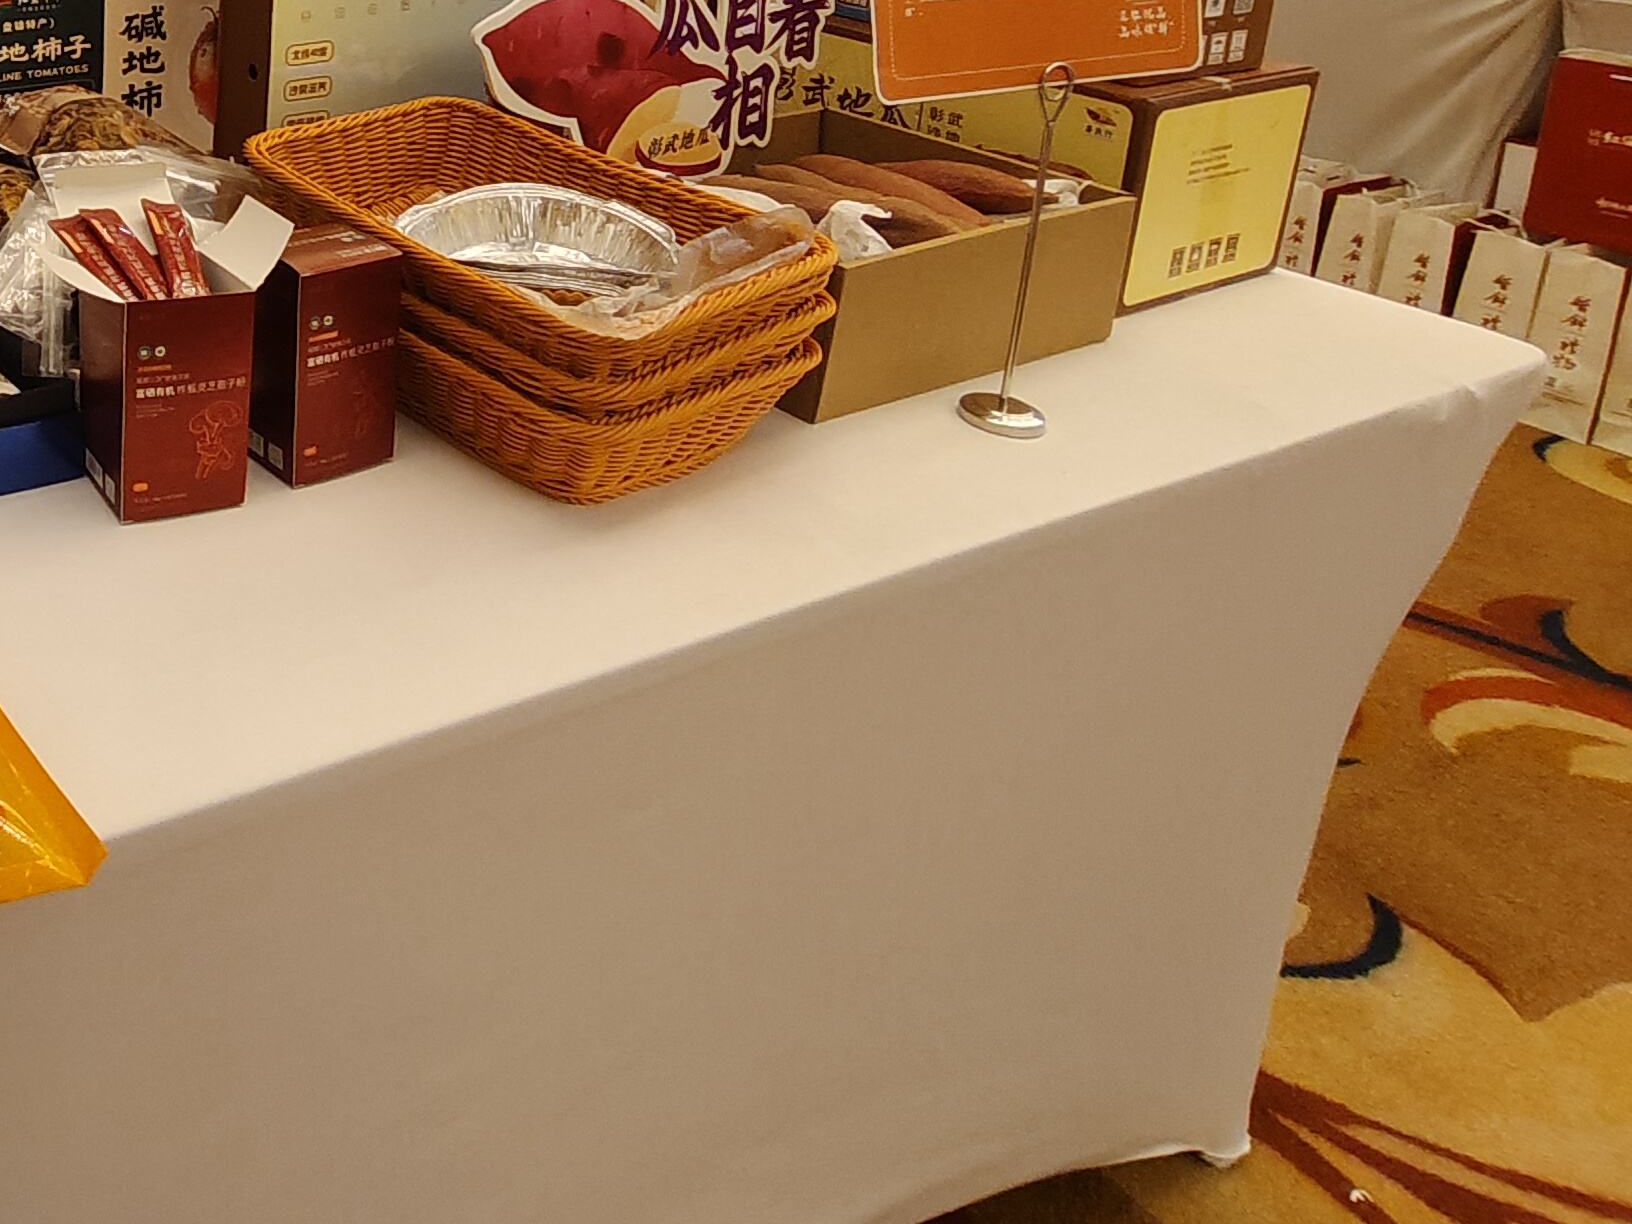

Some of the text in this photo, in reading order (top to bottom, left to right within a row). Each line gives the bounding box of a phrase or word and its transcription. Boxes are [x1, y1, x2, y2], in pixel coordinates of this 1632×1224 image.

[27, 64, 89, 79] TOMATOES
[119, 5, 167, 117] 碱地柿
[930, 106, 964, 128] 彰武
[647, 127, 710, 159] 彰武地瓜
